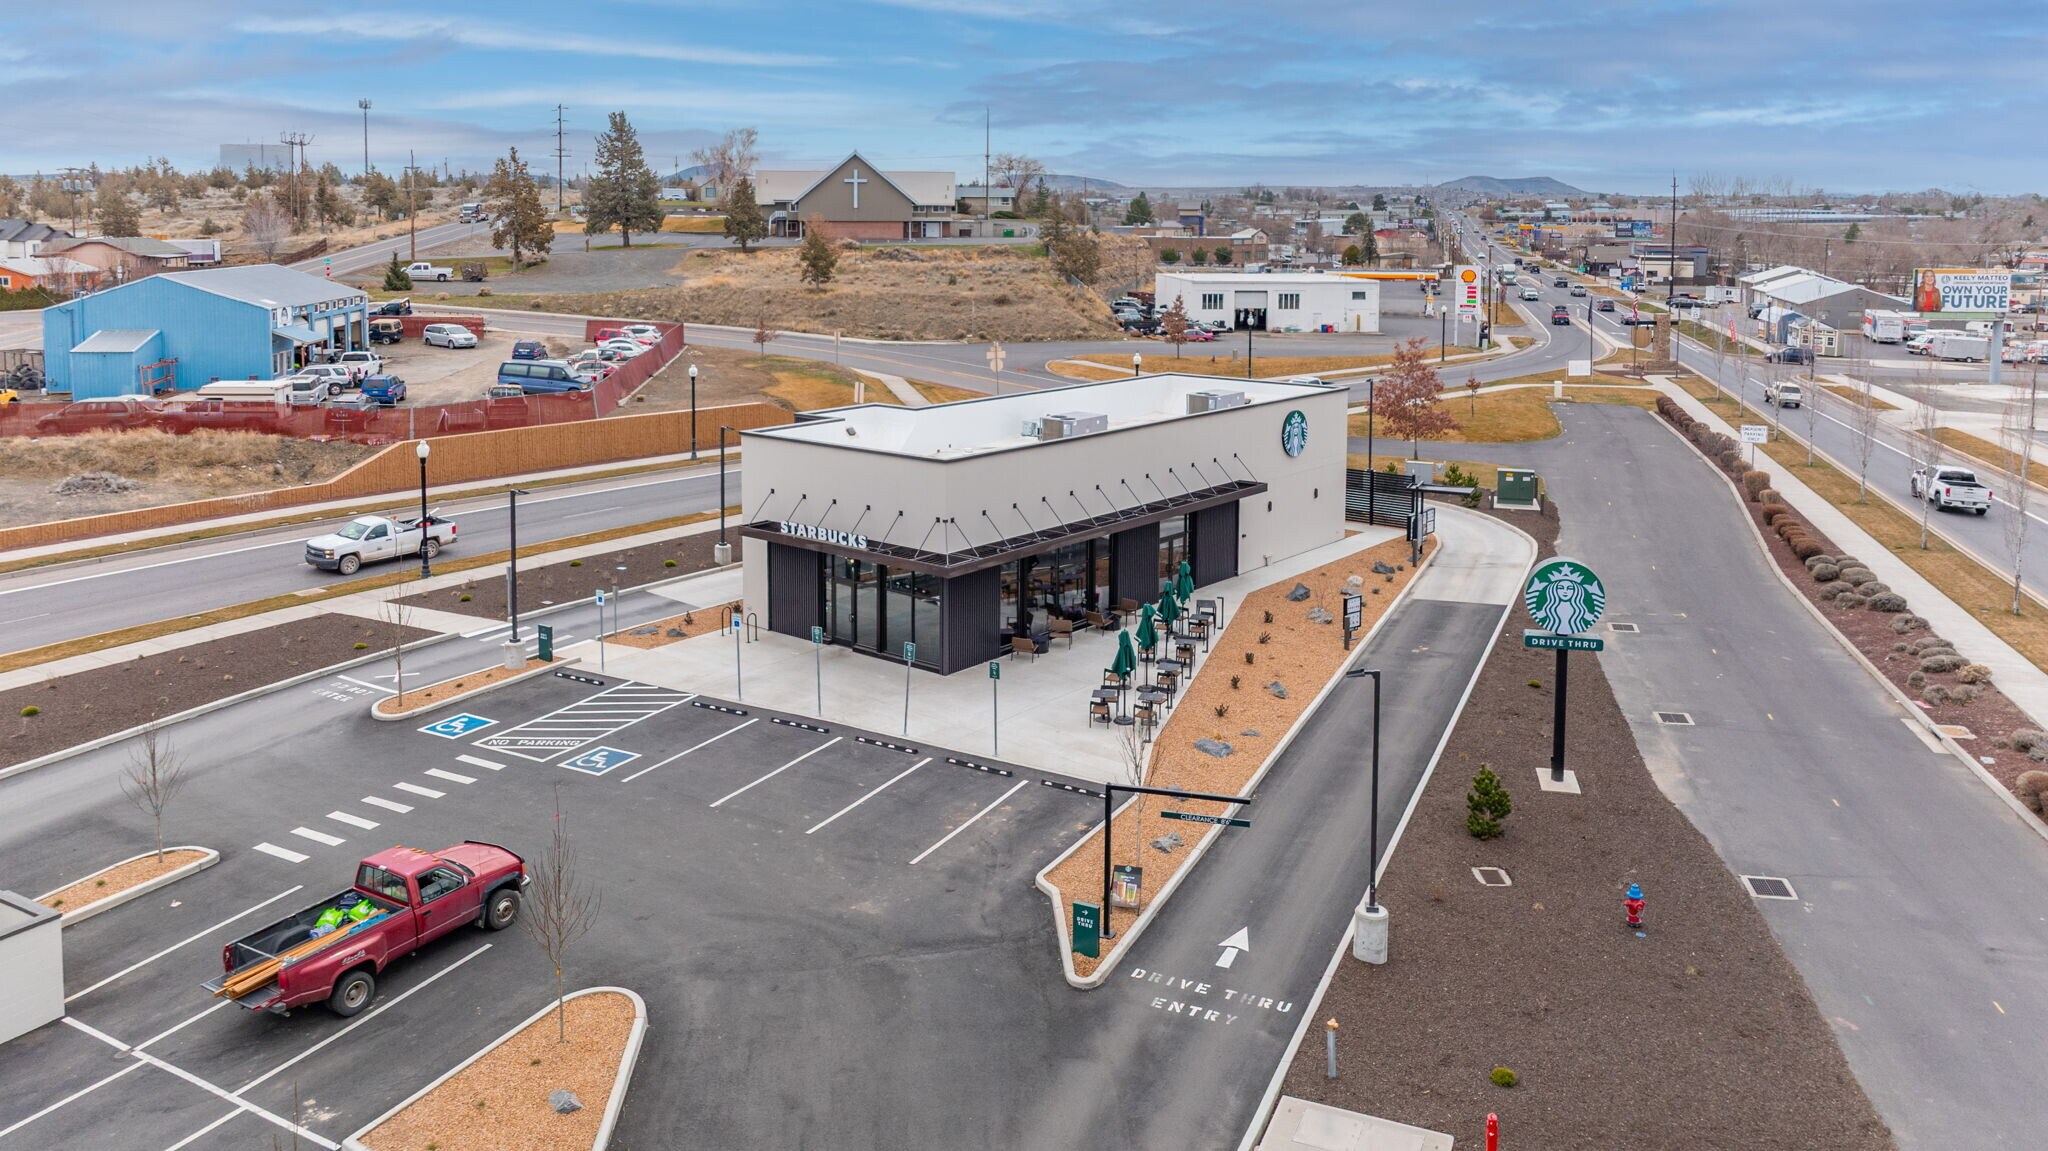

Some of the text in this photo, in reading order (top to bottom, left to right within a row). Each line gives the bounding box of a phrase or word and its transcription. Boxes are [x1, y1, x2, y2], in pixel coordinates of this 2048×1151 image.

[1942, 286, 2008, 294] OWN YOUR
[1942, 295, 2008, 308] FUTURE
[780, 520, 867, 549] STARBUCKS
[1531, 638, 1597, 649] DRIVE THRU
[1180, 814, 1218, 824] CLEARANCE
[1076, 916, 1094, 925] DRIVE
[1077, 921, 1093, 929] THRU
[1131, 968, 1293, 1013] DRIVE THRU
[1150, 997, 1238, 1025] ENTRY
